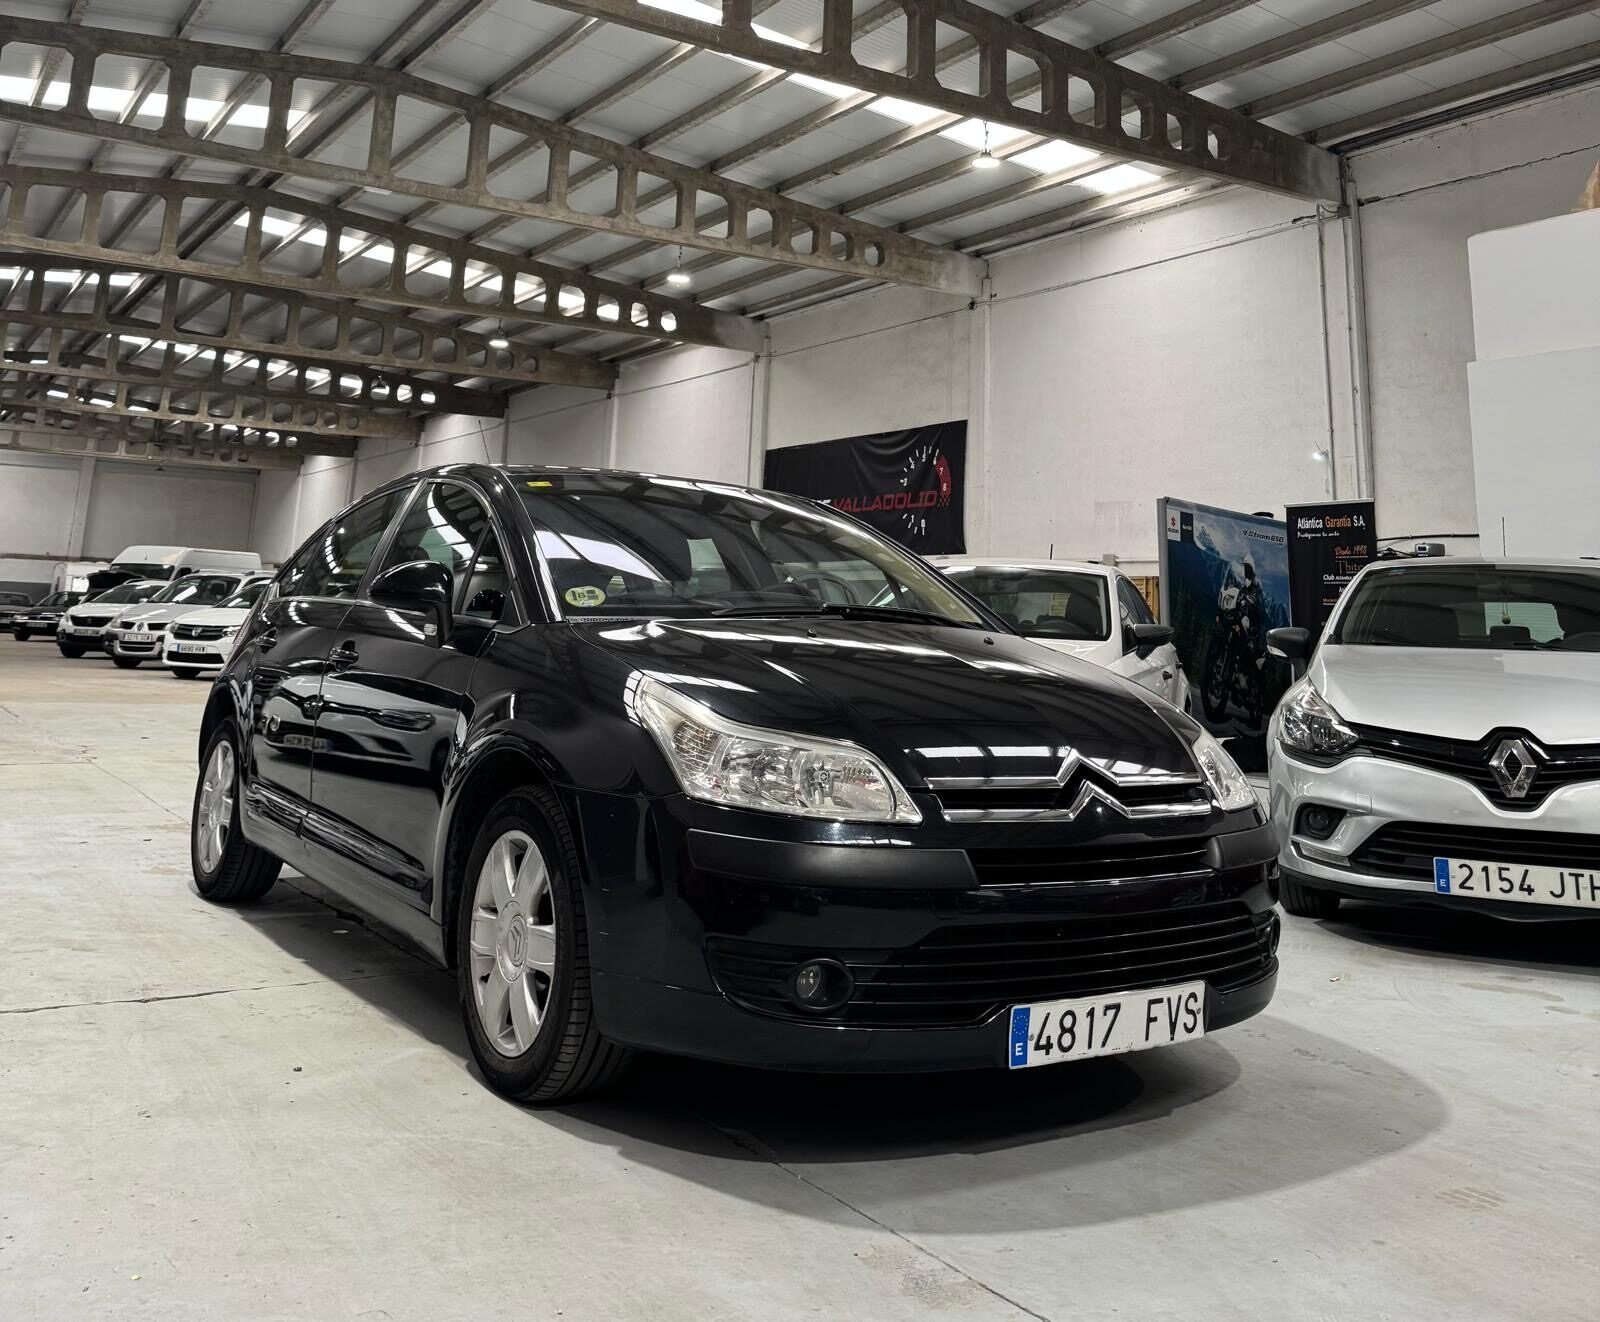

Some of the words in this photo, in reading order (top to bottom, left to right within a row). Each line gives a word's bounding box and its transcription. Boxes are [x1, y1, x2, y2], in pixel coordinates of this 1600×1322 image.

[939, 467, 944, 475] 7
[832, 490, 938, 513] VALLADOLID
[1297, 516, 1323, 529] Atlántica
[1353, 515, 1366, 527] S.A.
[1440, 878, 1447, 887] E
[1458, 863, 1535, 896] 2154
[1033, 1002, 1122, 1056] 4817
[1144, 991, 1198, 1042] FVS
[1015, 1042, 1024, 1056] E
